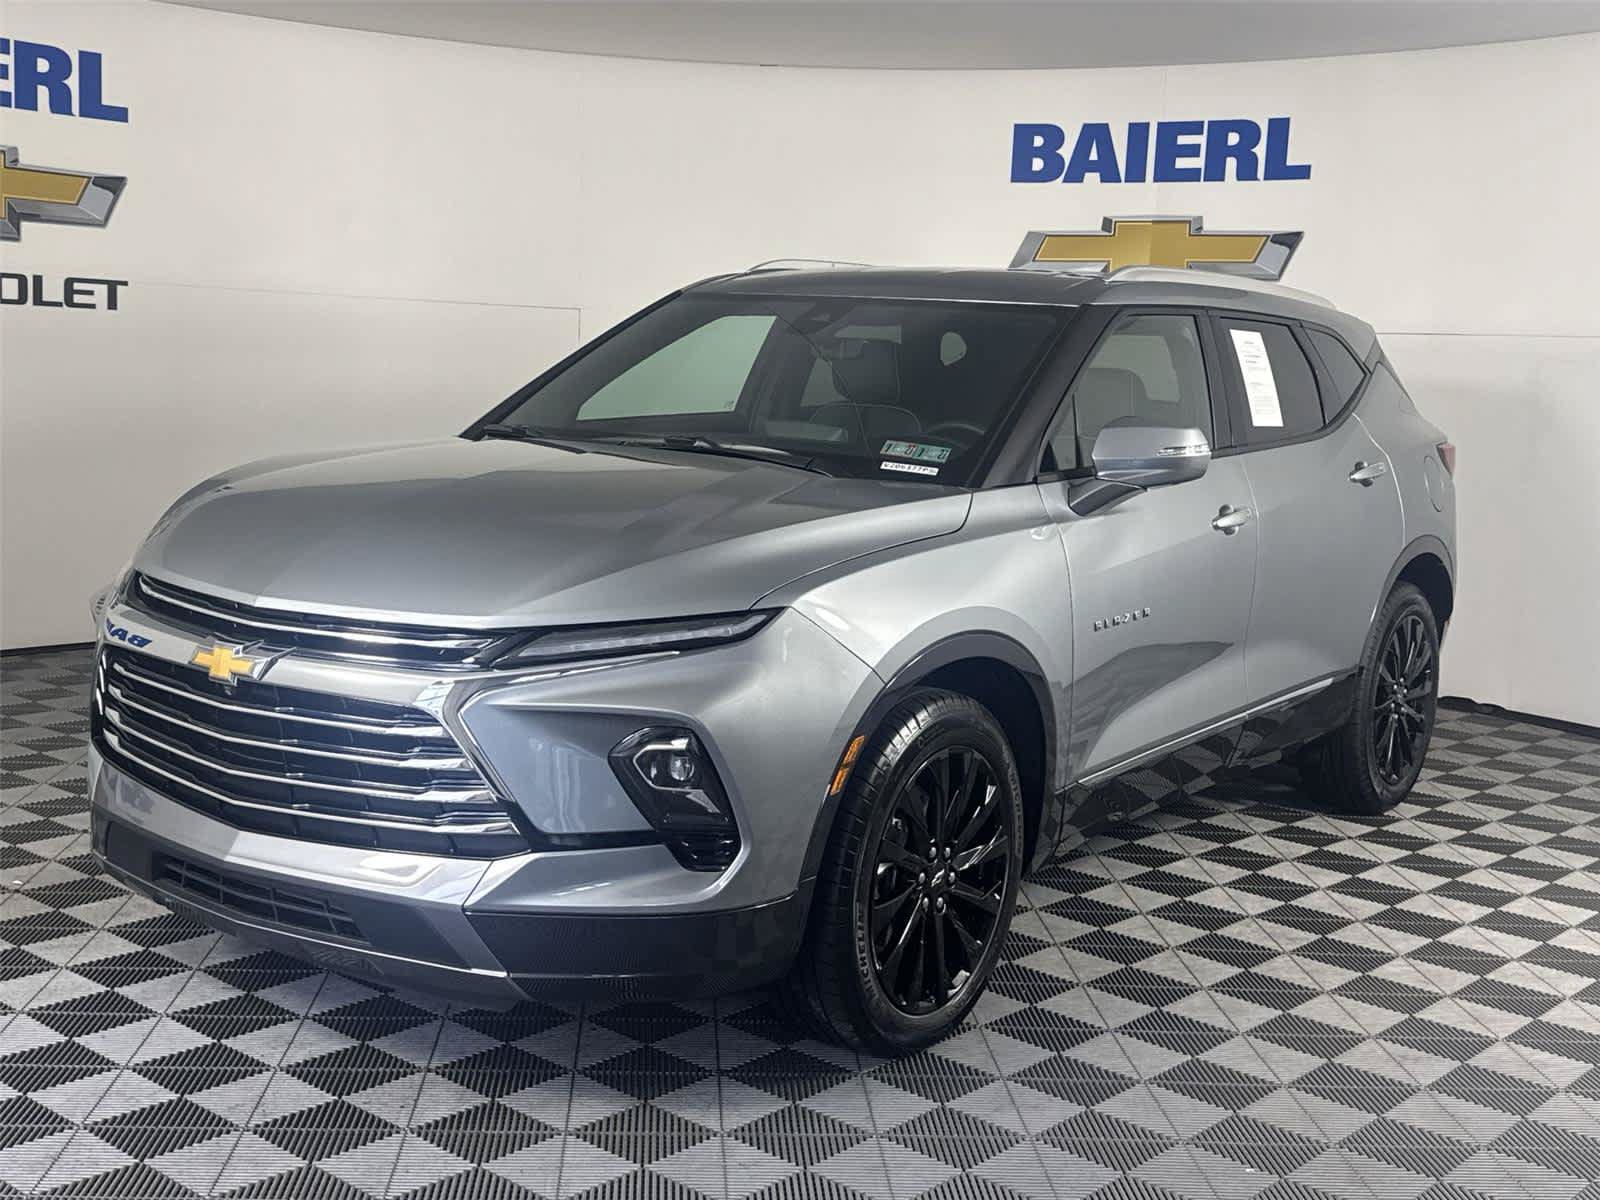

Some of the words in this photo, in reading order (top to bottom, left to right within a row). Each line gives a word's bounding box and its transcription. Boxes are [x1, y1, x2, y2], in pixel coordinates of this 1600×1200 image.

[0, 38, 128, 123] RL
[1010, 117, 1312, 183] BAIERL
[1094, 607, 1151, 632] BLAZER
[855, 904, 881, 1000] MICHELIN
